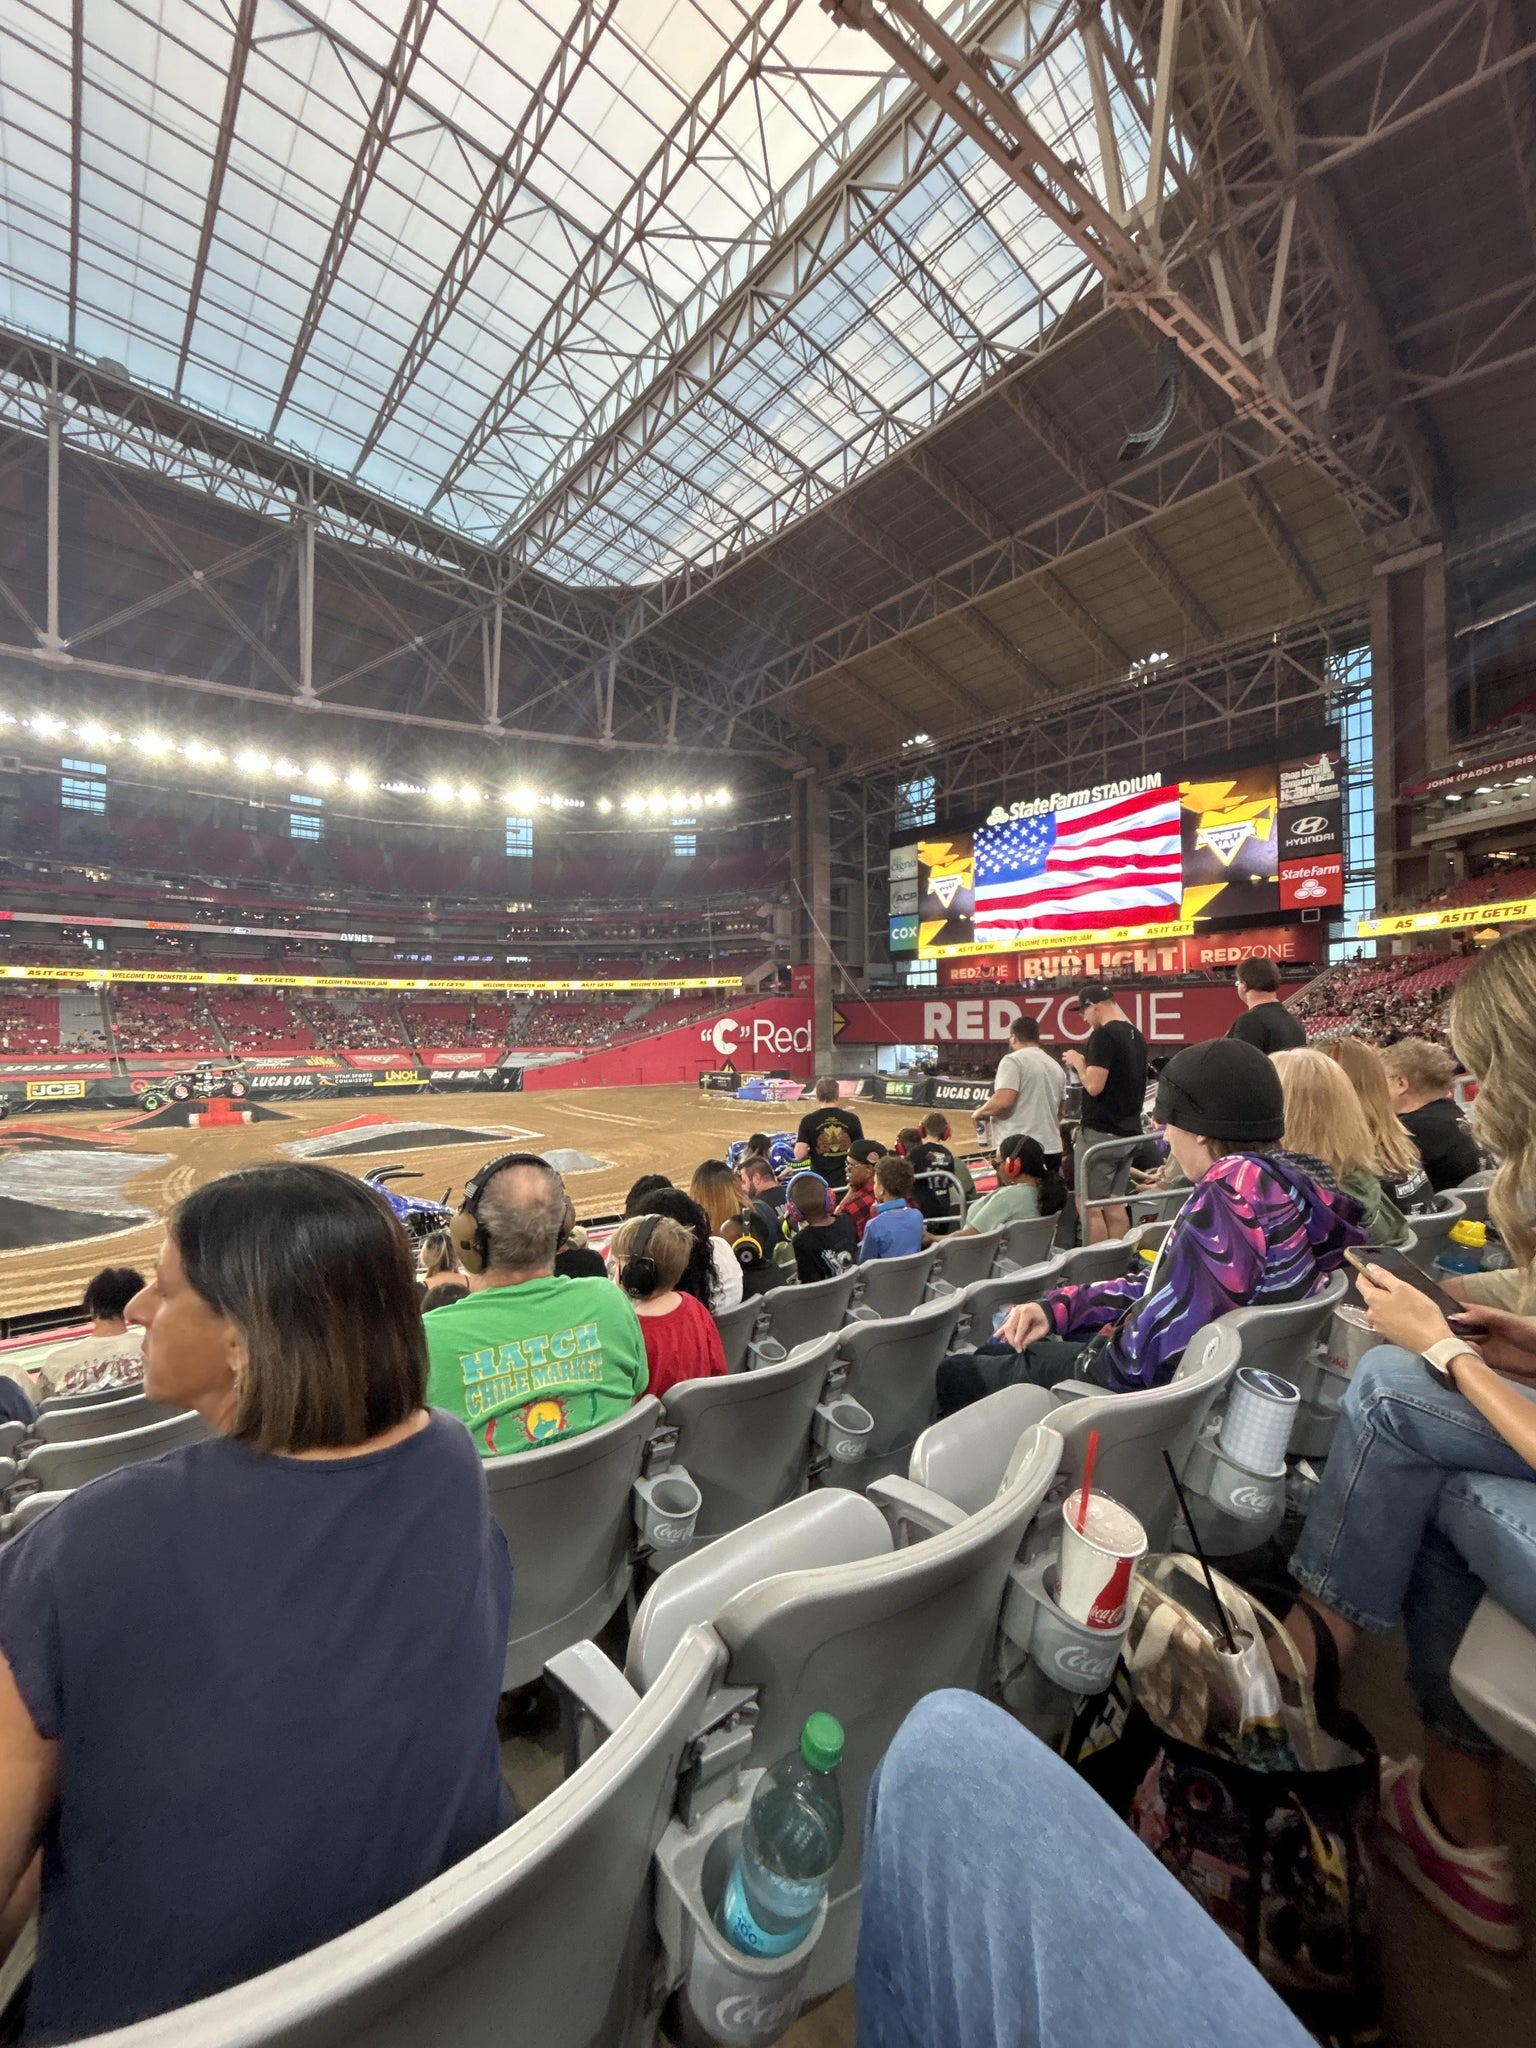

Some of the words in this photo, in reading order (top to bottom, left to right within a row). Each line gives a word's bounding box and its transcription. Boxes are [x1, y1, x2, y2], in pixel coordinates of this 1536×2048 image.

[1280, 770, 1300, 781] Shop
[1280, 776, 1312, 789] Support
[1313, 770, 1335, 783] Local
[1426, 776, 1454, 790] JOHN
[1457, 763, 1504, 782] (PADDY)
[1092, 772, 1162, 801] STADIUM
[1286, 832, 1334, 847] HYUNDAI
[1395, 920, 1412, 929] AS
[1440, 914, 1460, 924] AS
[1462, 911, 1479, 921] IT
[1481, 905, 1528, 919] GETS!
[892, 926, 917, 940] COX
[1014, 939, 1040, 948] WELCOME
[1050, 936, 1077, 945] MONSTER
[1079, 934, 1093, 942] JAM
[1201, 943, 1295, 963] REDZONE
[1024, 953, 1083, 979] BUD
[753, 1019, 812, 1054] Red
[0, 1064, 68, 1072] UCAS
[385, 1070, 418, 1081] UNOH
[252, 1075, 291, 1087] LUCAS
[293, 1075, 313, 1086] OIL
[32, 1084, 80, 1096] JCB
[936, 1086, 971, 1099] LUCAS
[972, 1088, 990, 1100] OIL
[459, 1322, 602, 1386] HATCH
[465, 1370, 530, 1418] CHILE
[531, 1351, 603, 1391] MARKET
